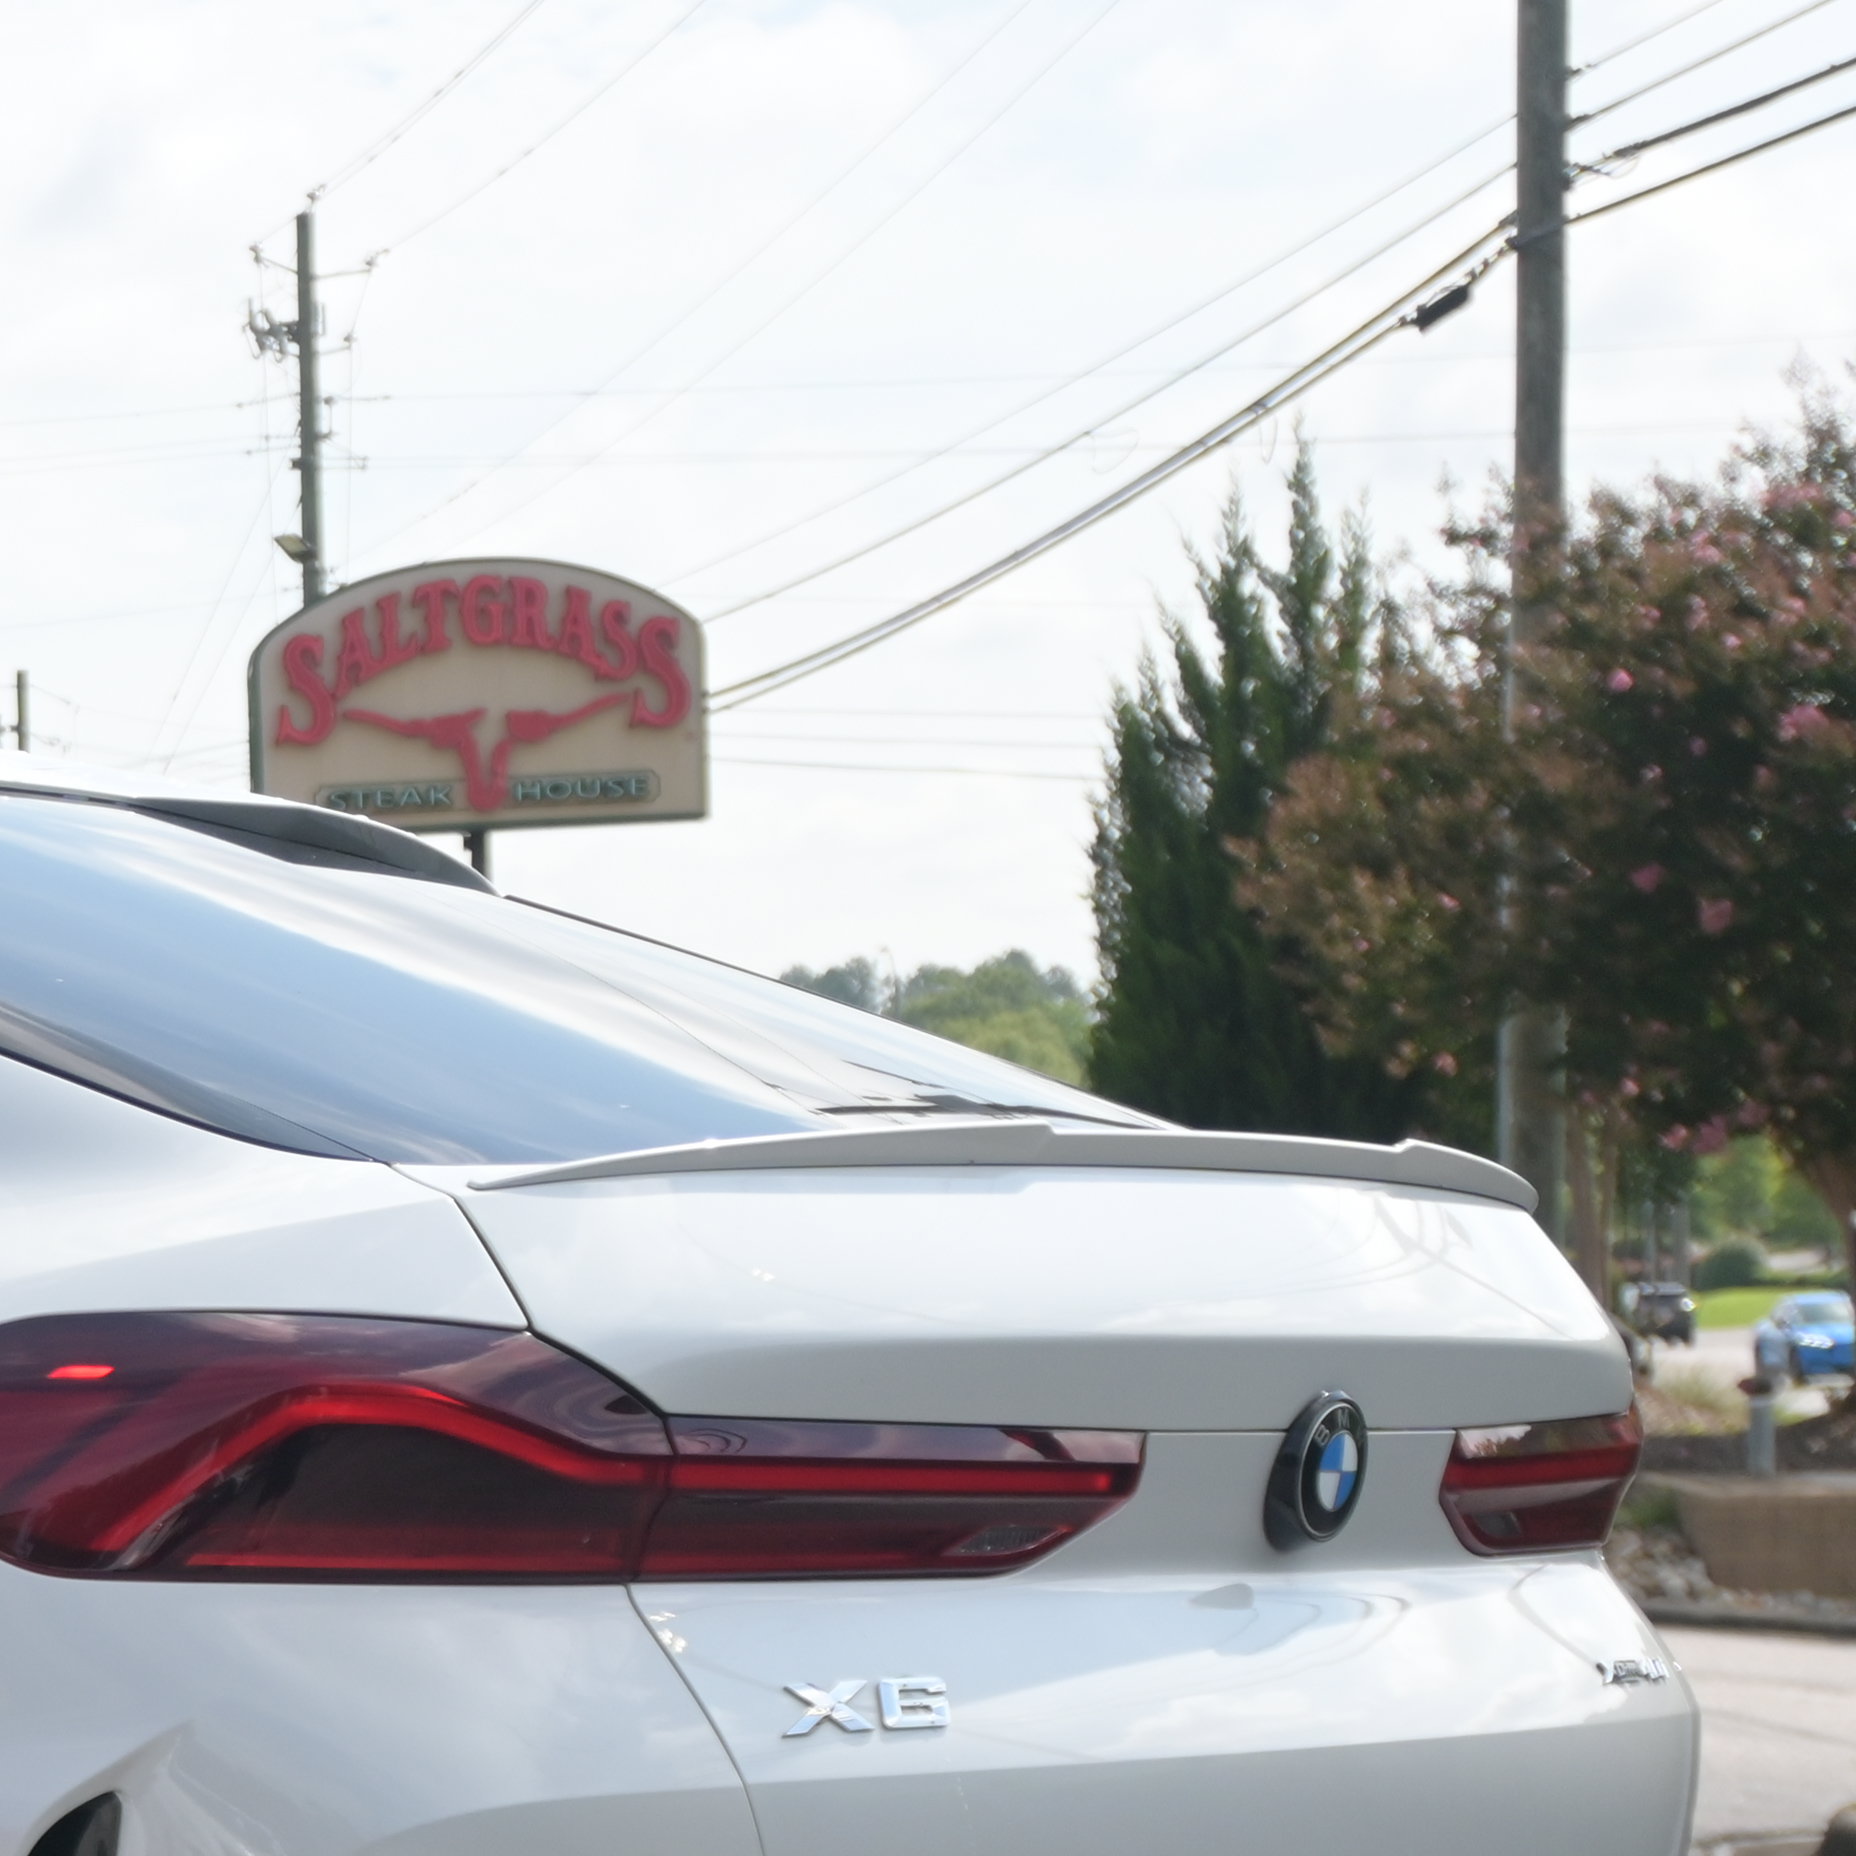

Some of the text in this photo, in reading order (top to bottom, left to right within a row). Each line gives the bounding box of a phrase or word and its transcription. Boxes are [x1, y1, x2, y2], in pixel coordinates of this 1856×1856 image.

[275, 573, 692, 747] SALTGRASS
[328, 776, 651, 810] STEAK HOUSE
[781, 1676, 951, 1739] X6
